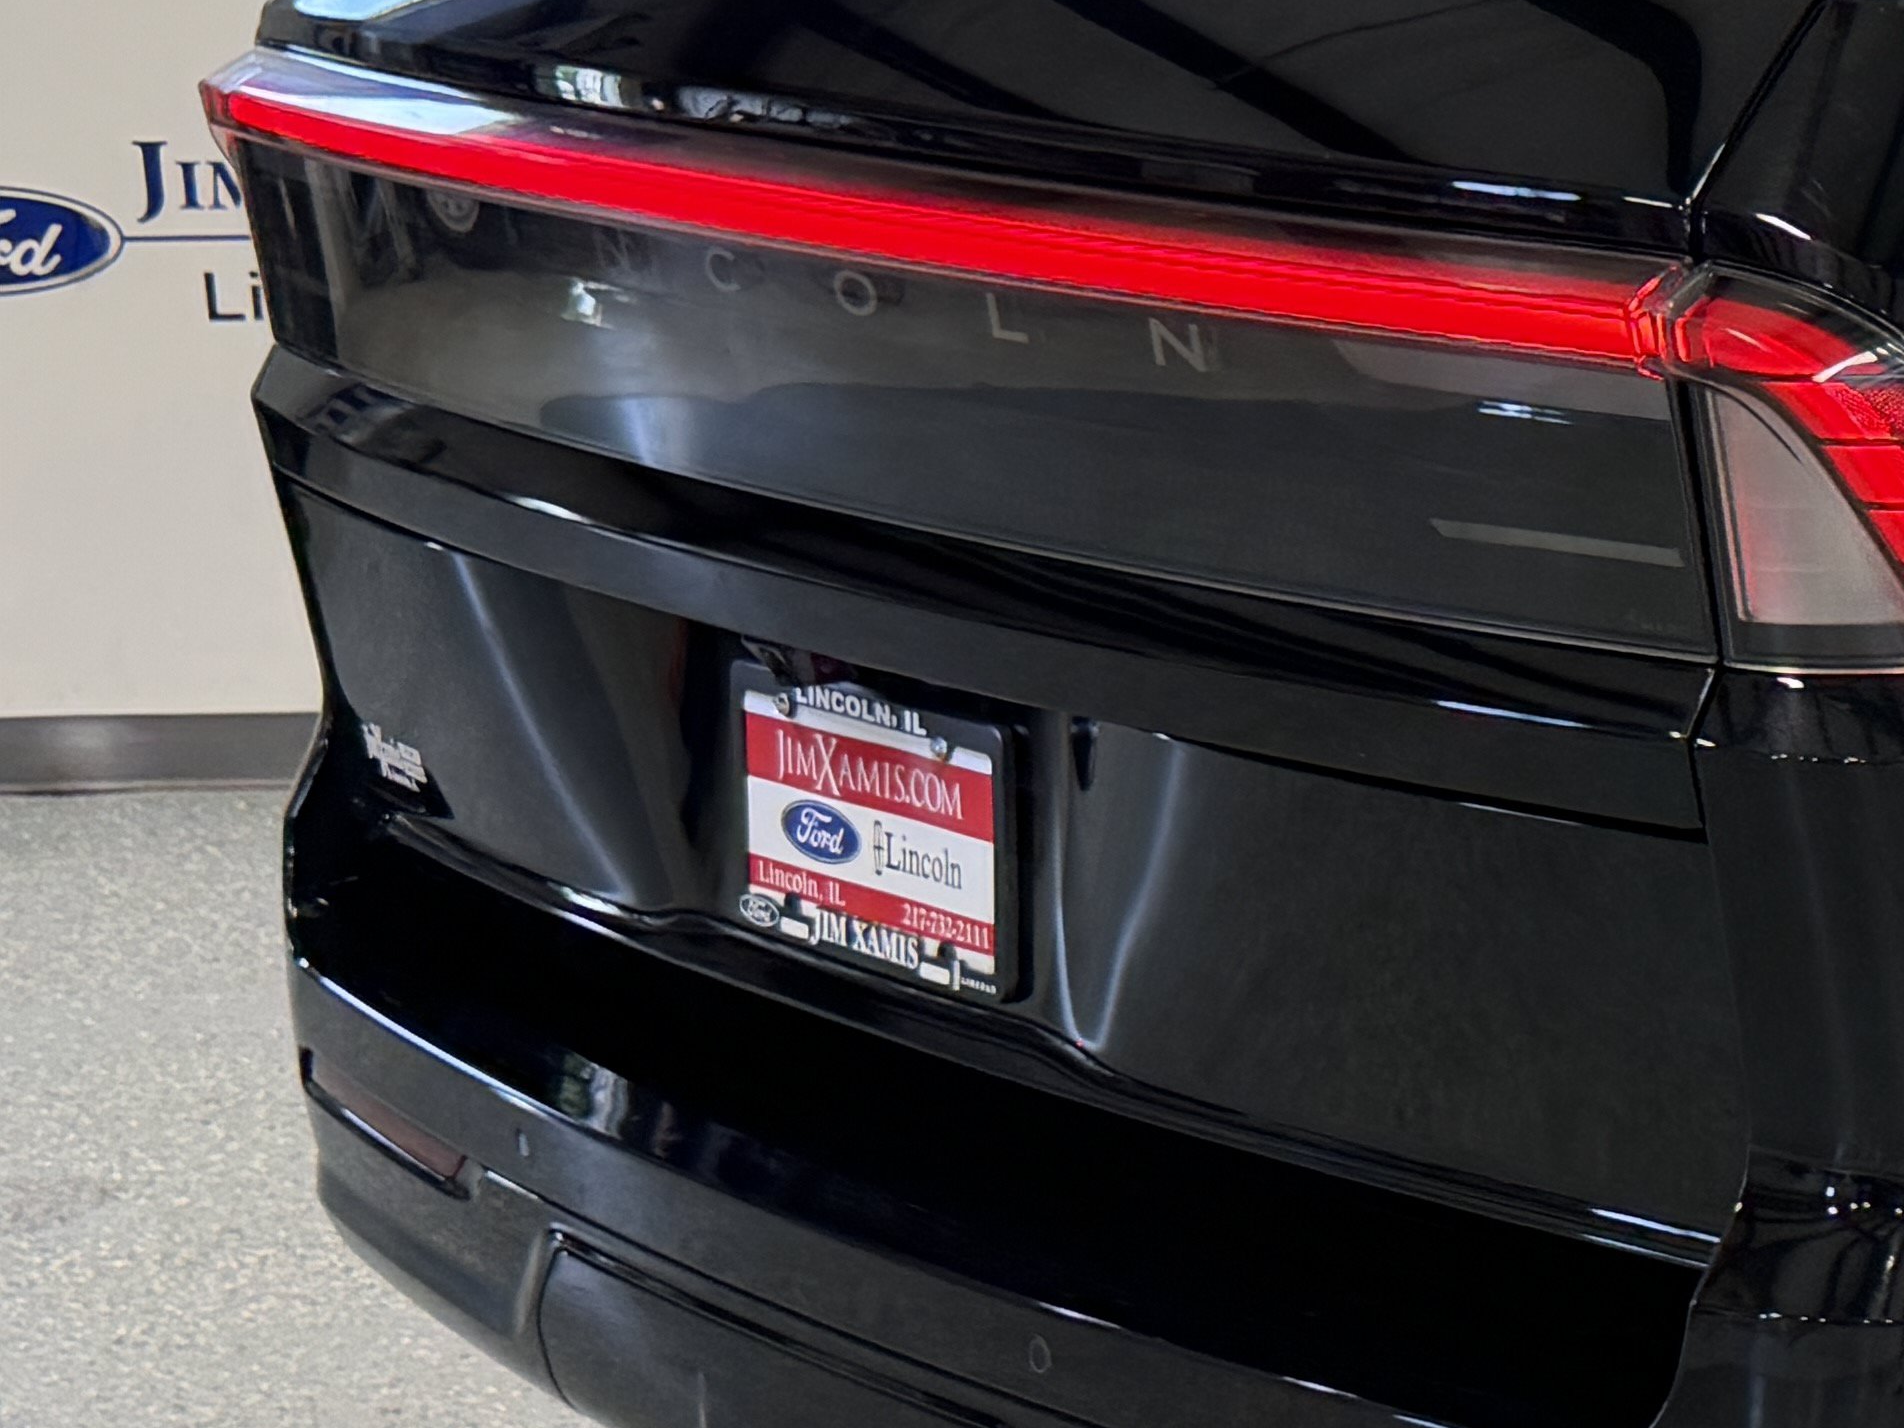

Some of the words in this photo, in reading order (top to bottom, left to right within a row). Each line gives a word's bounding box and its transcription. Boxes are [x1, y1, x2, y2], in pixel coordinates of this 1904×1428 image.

[794, 687, 898, 728] LINCOLN,
[904, 710, 927, 736] IL
[775, 728, 964, 820] JIMXAMIS.COM
[796, 806, 846, 855] Ford
[885, 831, 962, 890] Lincoln
[809, 908, 847, 946] JIM
[851, 919, 920, 971] XAMIS
[902, 902, 990, 950] 217-732-2111
